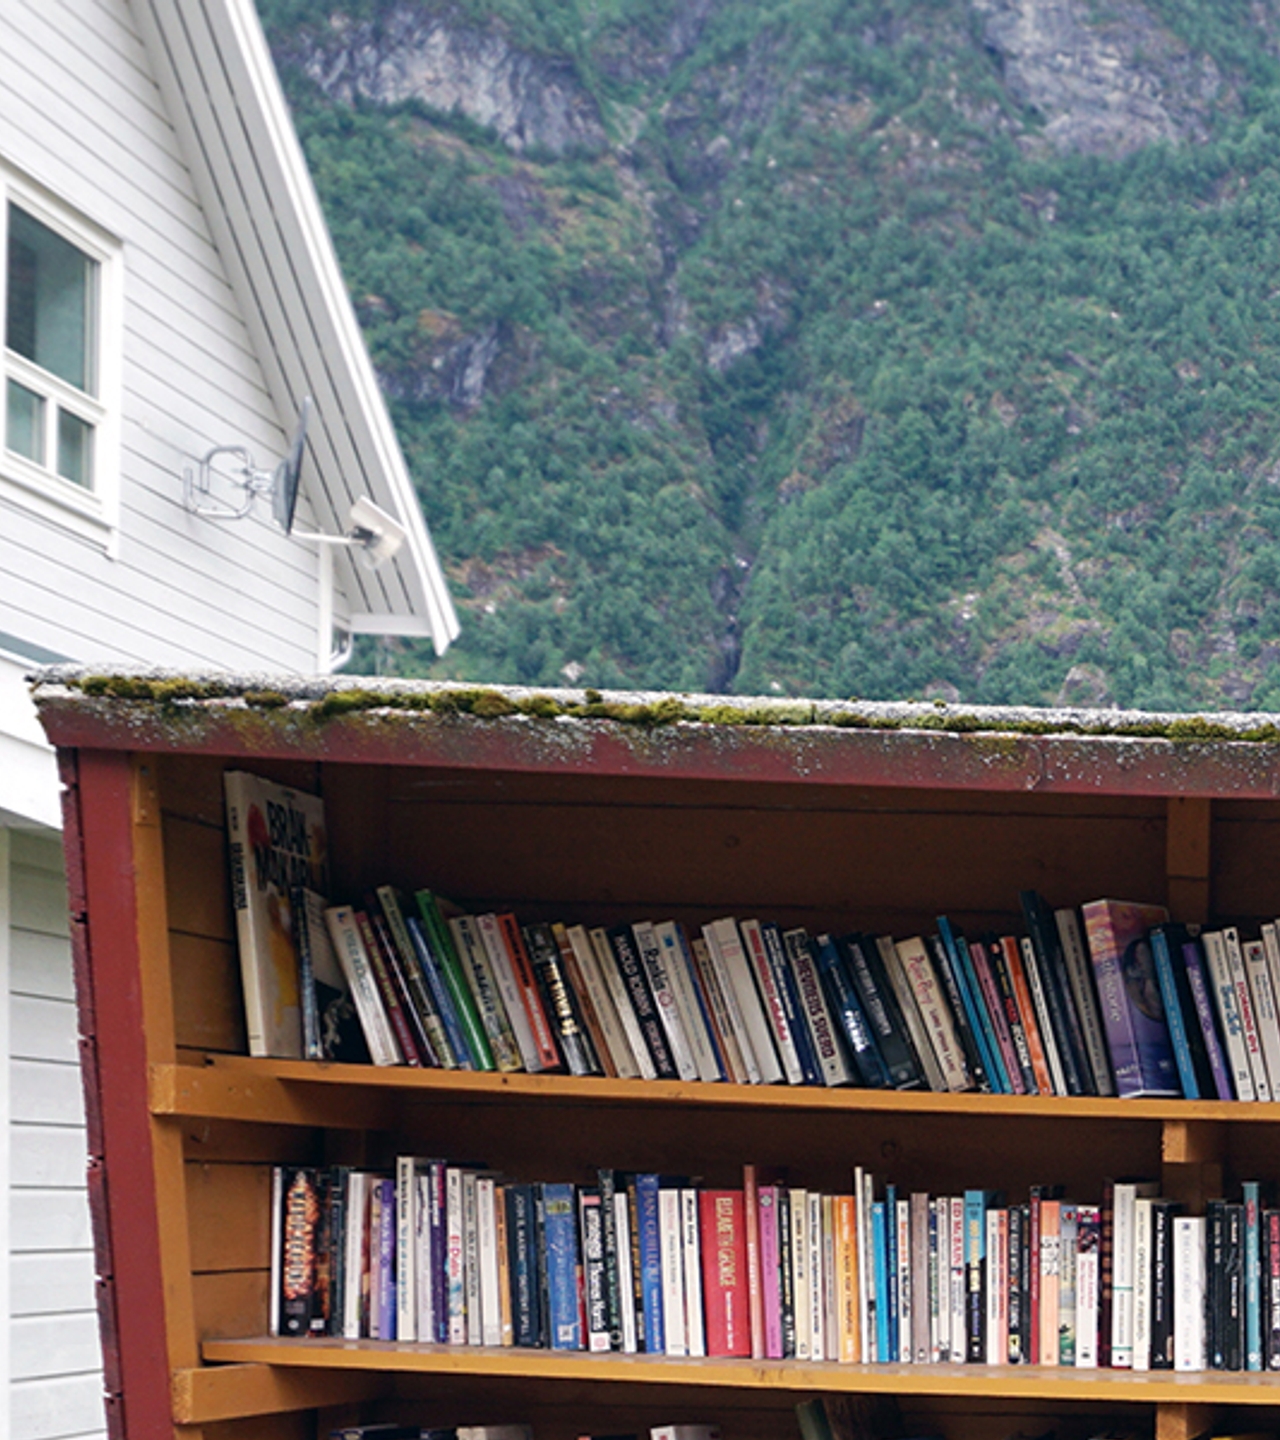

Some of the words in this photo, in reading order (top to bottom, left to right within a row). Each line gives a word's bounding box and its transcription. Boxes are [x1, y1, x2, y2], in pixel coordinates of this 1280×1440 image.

[643, 1191, 657, 1217] JAN
[714, 1197, 734, 1247] ELIZABETH
[952, 1202, 962, 1215] ED
[645, 1219, 661, 1283] GUILLOU
[952, 1217, 963, 1265] McBAIN
[717, 1248, 737, 1287] GEORGE
